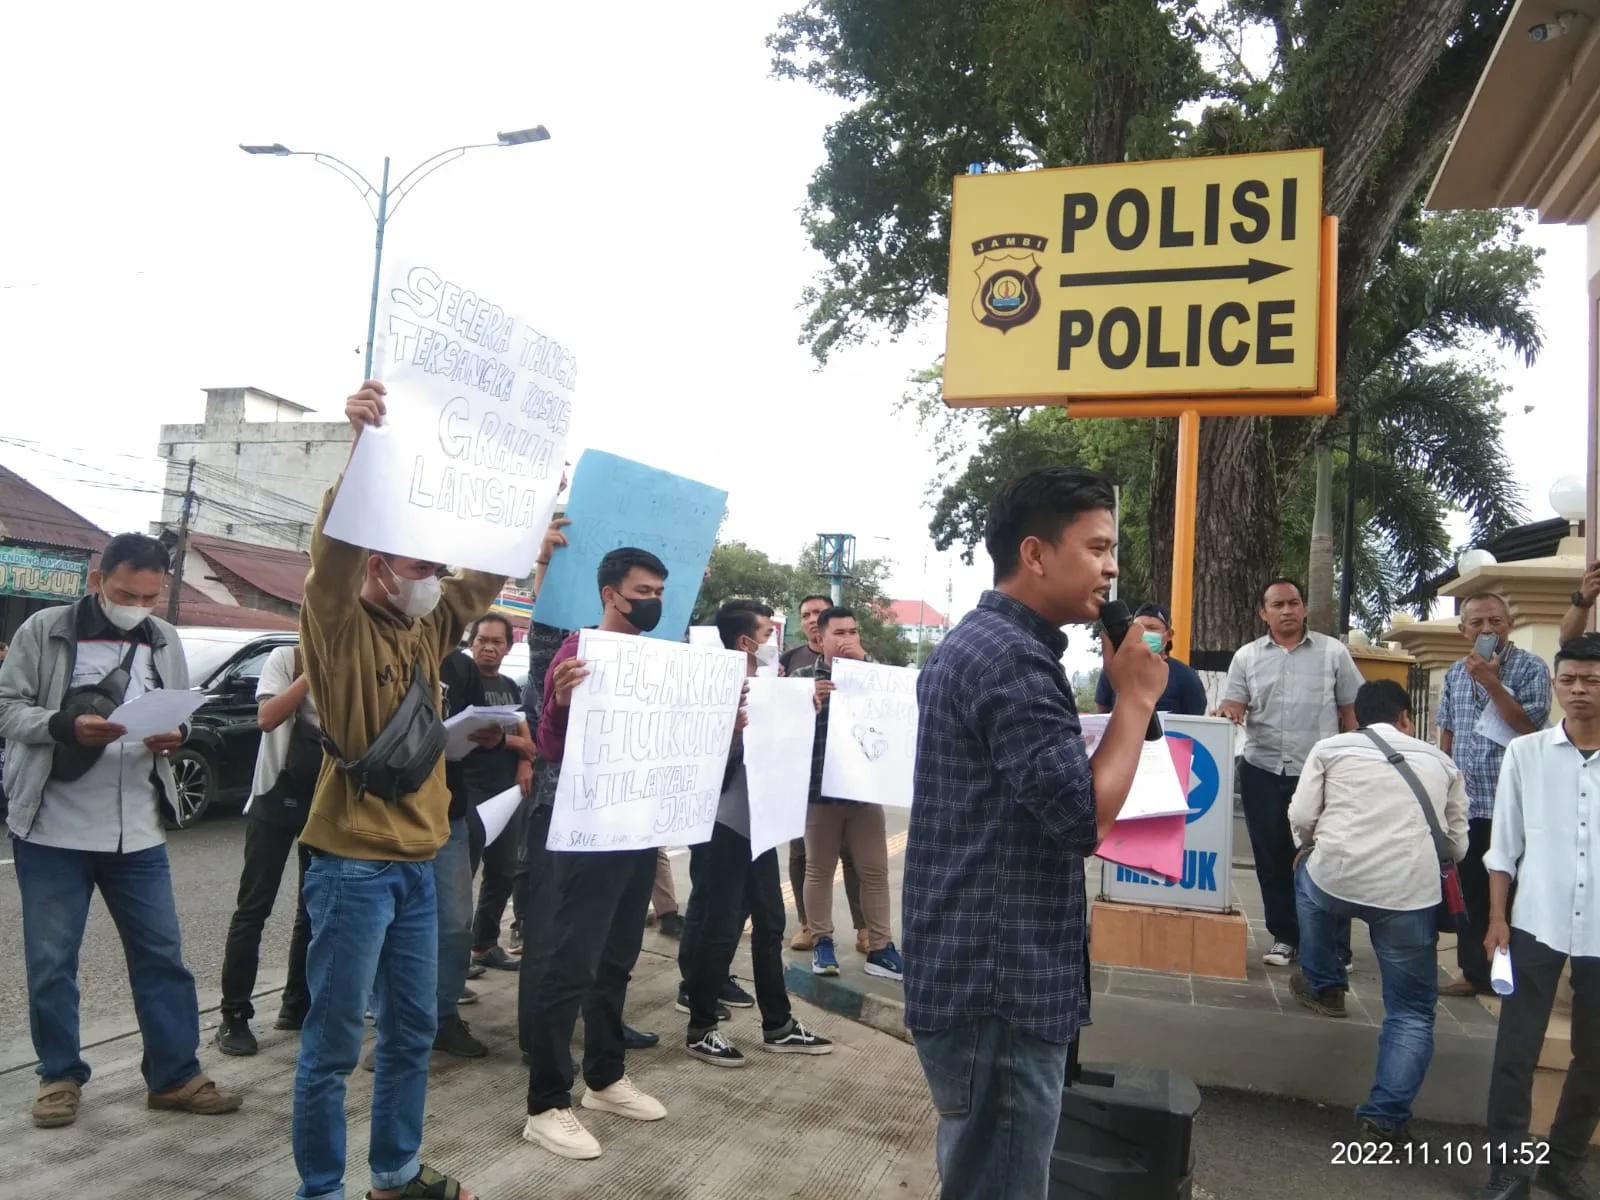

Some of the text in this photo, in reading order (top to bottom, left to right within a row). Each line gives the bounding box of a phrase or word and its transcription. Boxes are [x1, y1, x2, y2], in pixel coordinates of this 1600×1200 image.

[1060, 177, 1298, 254] POLISI
[977, 236, 1043, 252] JAMBI
[1056, 299, 1296, 371] POLICE
[408, 455, 537, 529] LANSIA
[11, 566, 80, 596] TUJUH
[582, 709, 733, 765] HUKUM
[572, 764, 699, 811] WILAYAH
